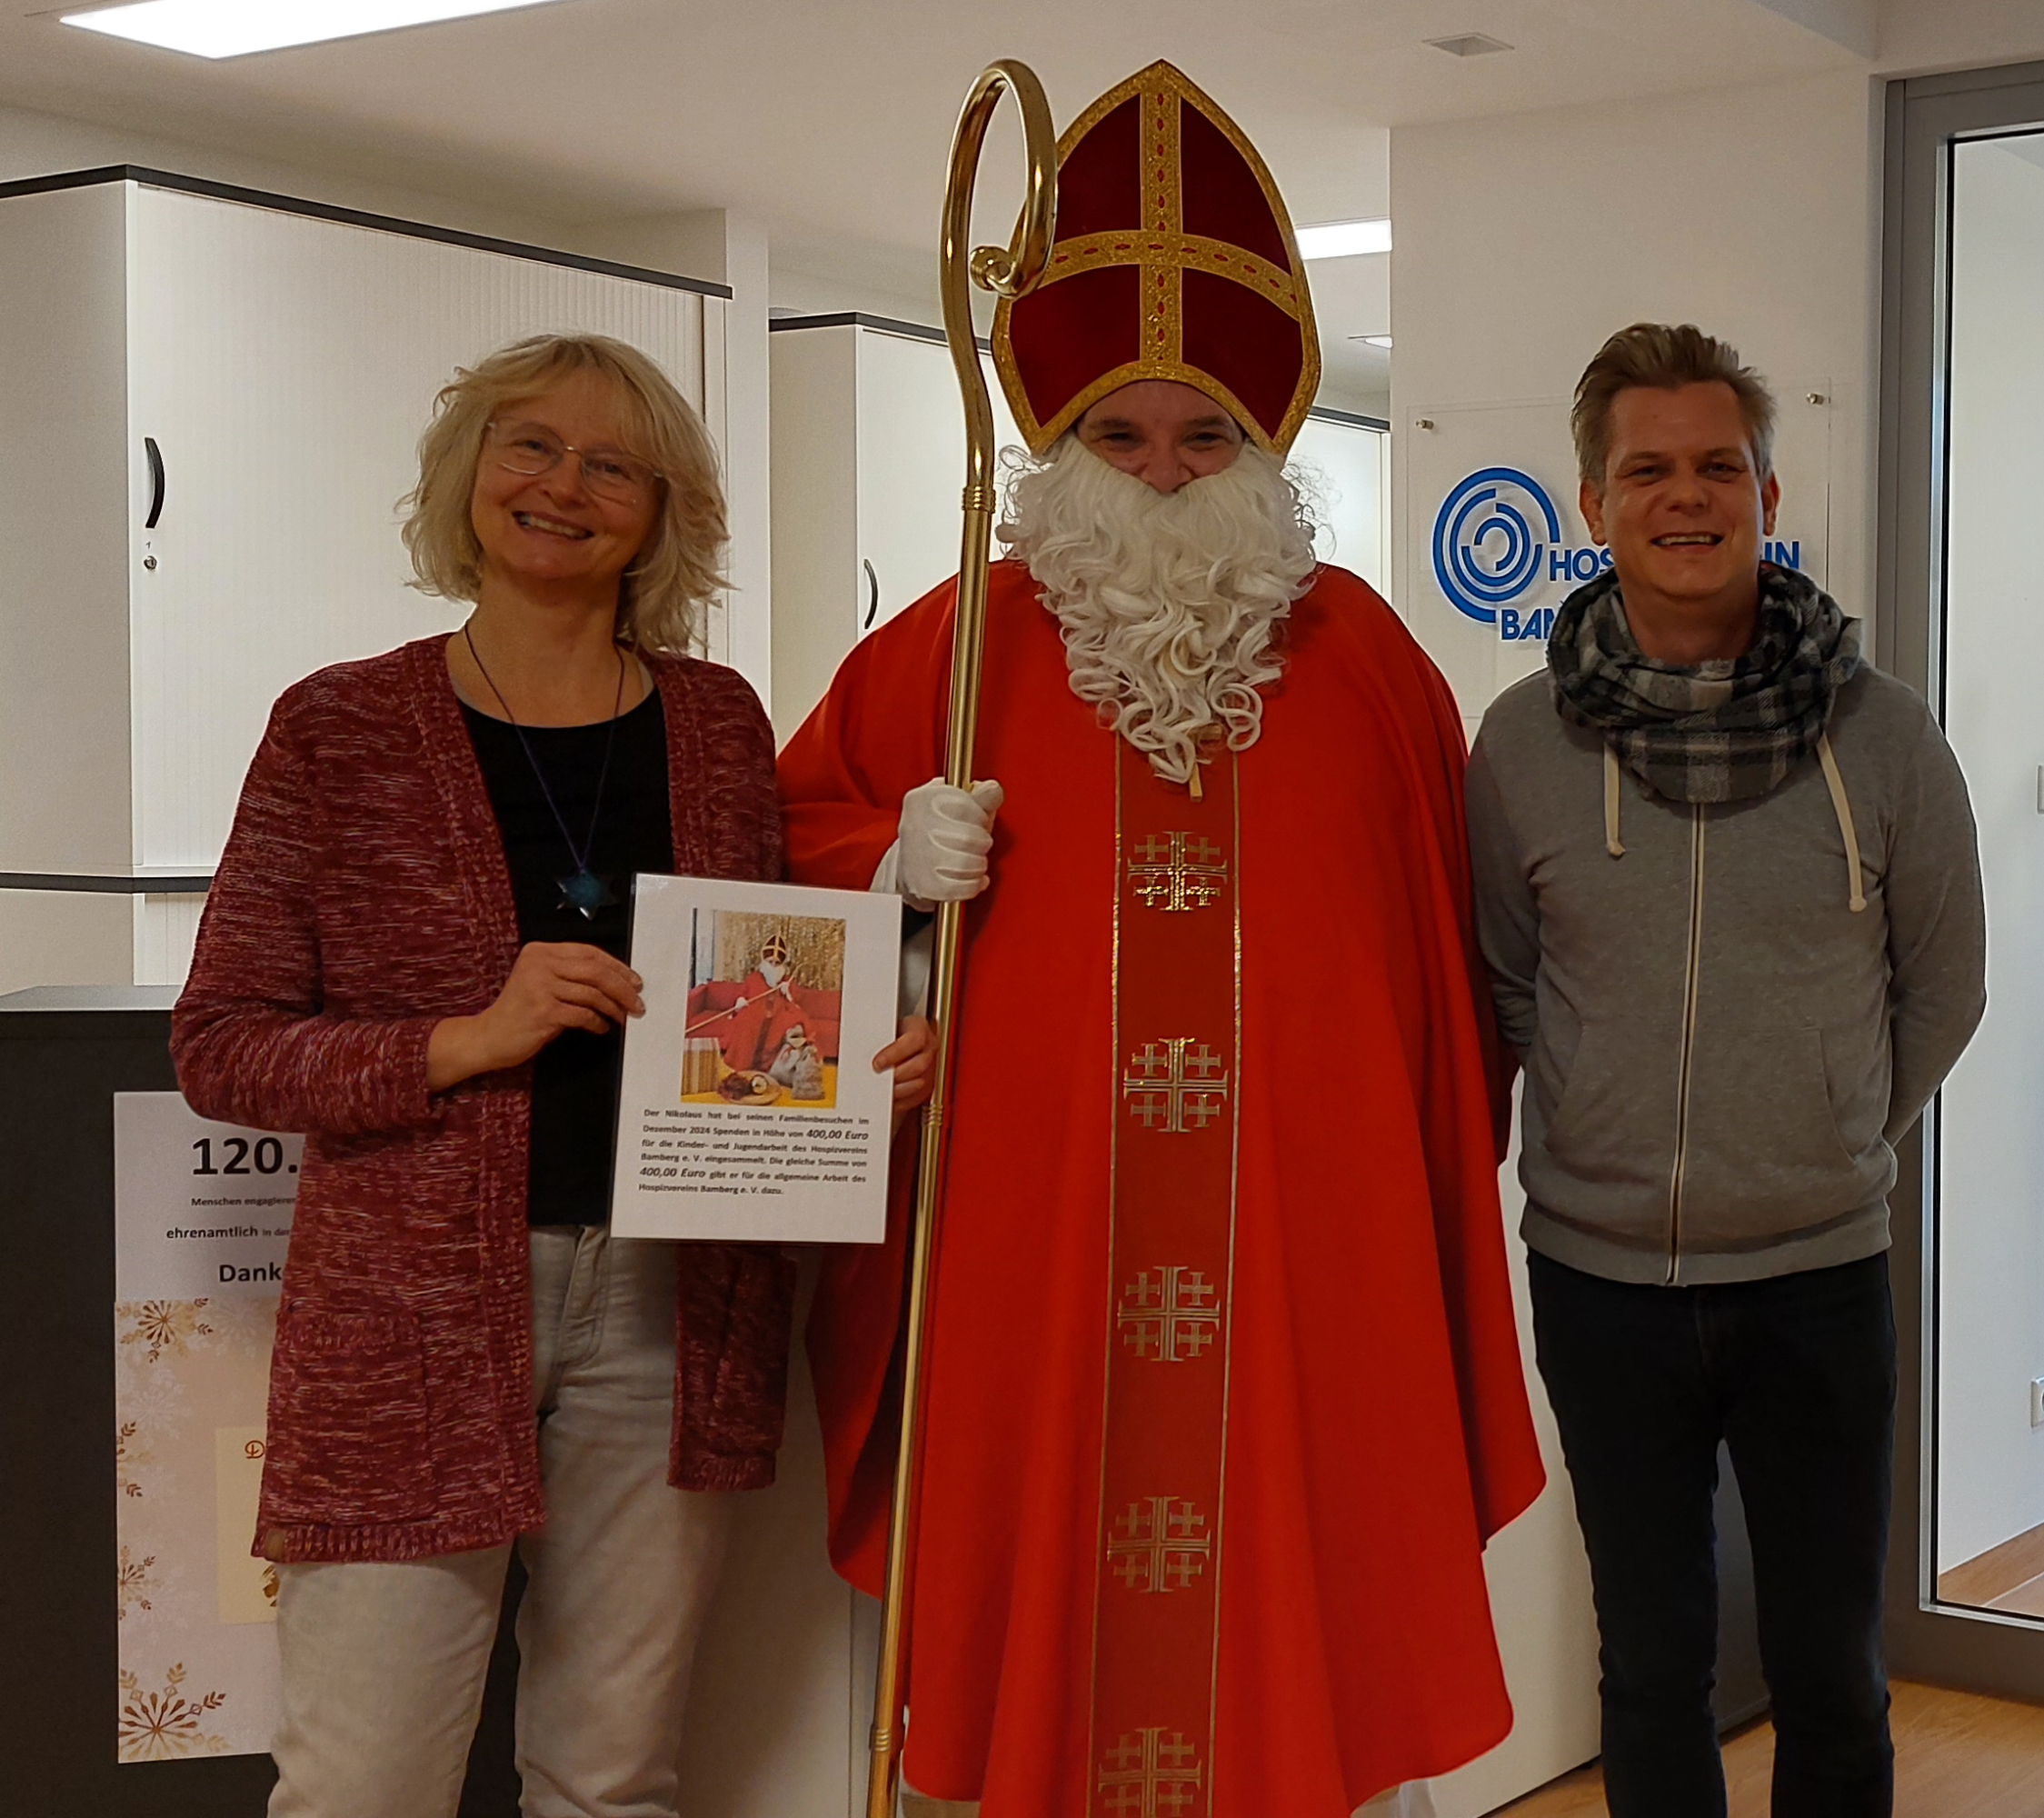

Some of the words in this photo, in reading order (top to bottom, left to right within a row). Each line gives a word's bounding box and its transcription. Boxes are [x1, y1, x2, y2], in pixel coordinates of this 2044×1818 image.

[664, 1109, 703, 1119] Nikolaus
[778, 1113, 853, 1124] Familienbesuchen
[643, 1124, 687, 1134] Dezember
[689, 1125, 711, 1134] 2024
[713, 1126, 750, 1136] Spenden
[806, 1128, 843, 1139] 400,00
[844, 1129, 869, 1140] Euro
[676, 1140, 709, 1149] Kinder-
[733, 1142, 788, 1152] Jugendarbeit
[811, 1145, 868, 1154] Hospizvereins
[641, 1152, 680, 1164] Bamberg
[785, 1157, 816, 1166] gleiche
[818, 1157, 850, 1166] Summe
[639, 1166, 678, 1178] 400,00
[680, 1167, 706, 1178] Euro
[709, 1170, 726, 1180] gibt
[773, 1172, 820, 1183] allgemeine
[822, 1173, 849, 1182] Arbeit
[638, 1183, 699, 1193] Hospizvereins
[700, 1184, 739, 1194] Bamberg
[191, 1196, 243, 1206] Menschen
[165, 1225, 259, 1239] ehrenamtlich
[262, 1228, 272, 1237] in
